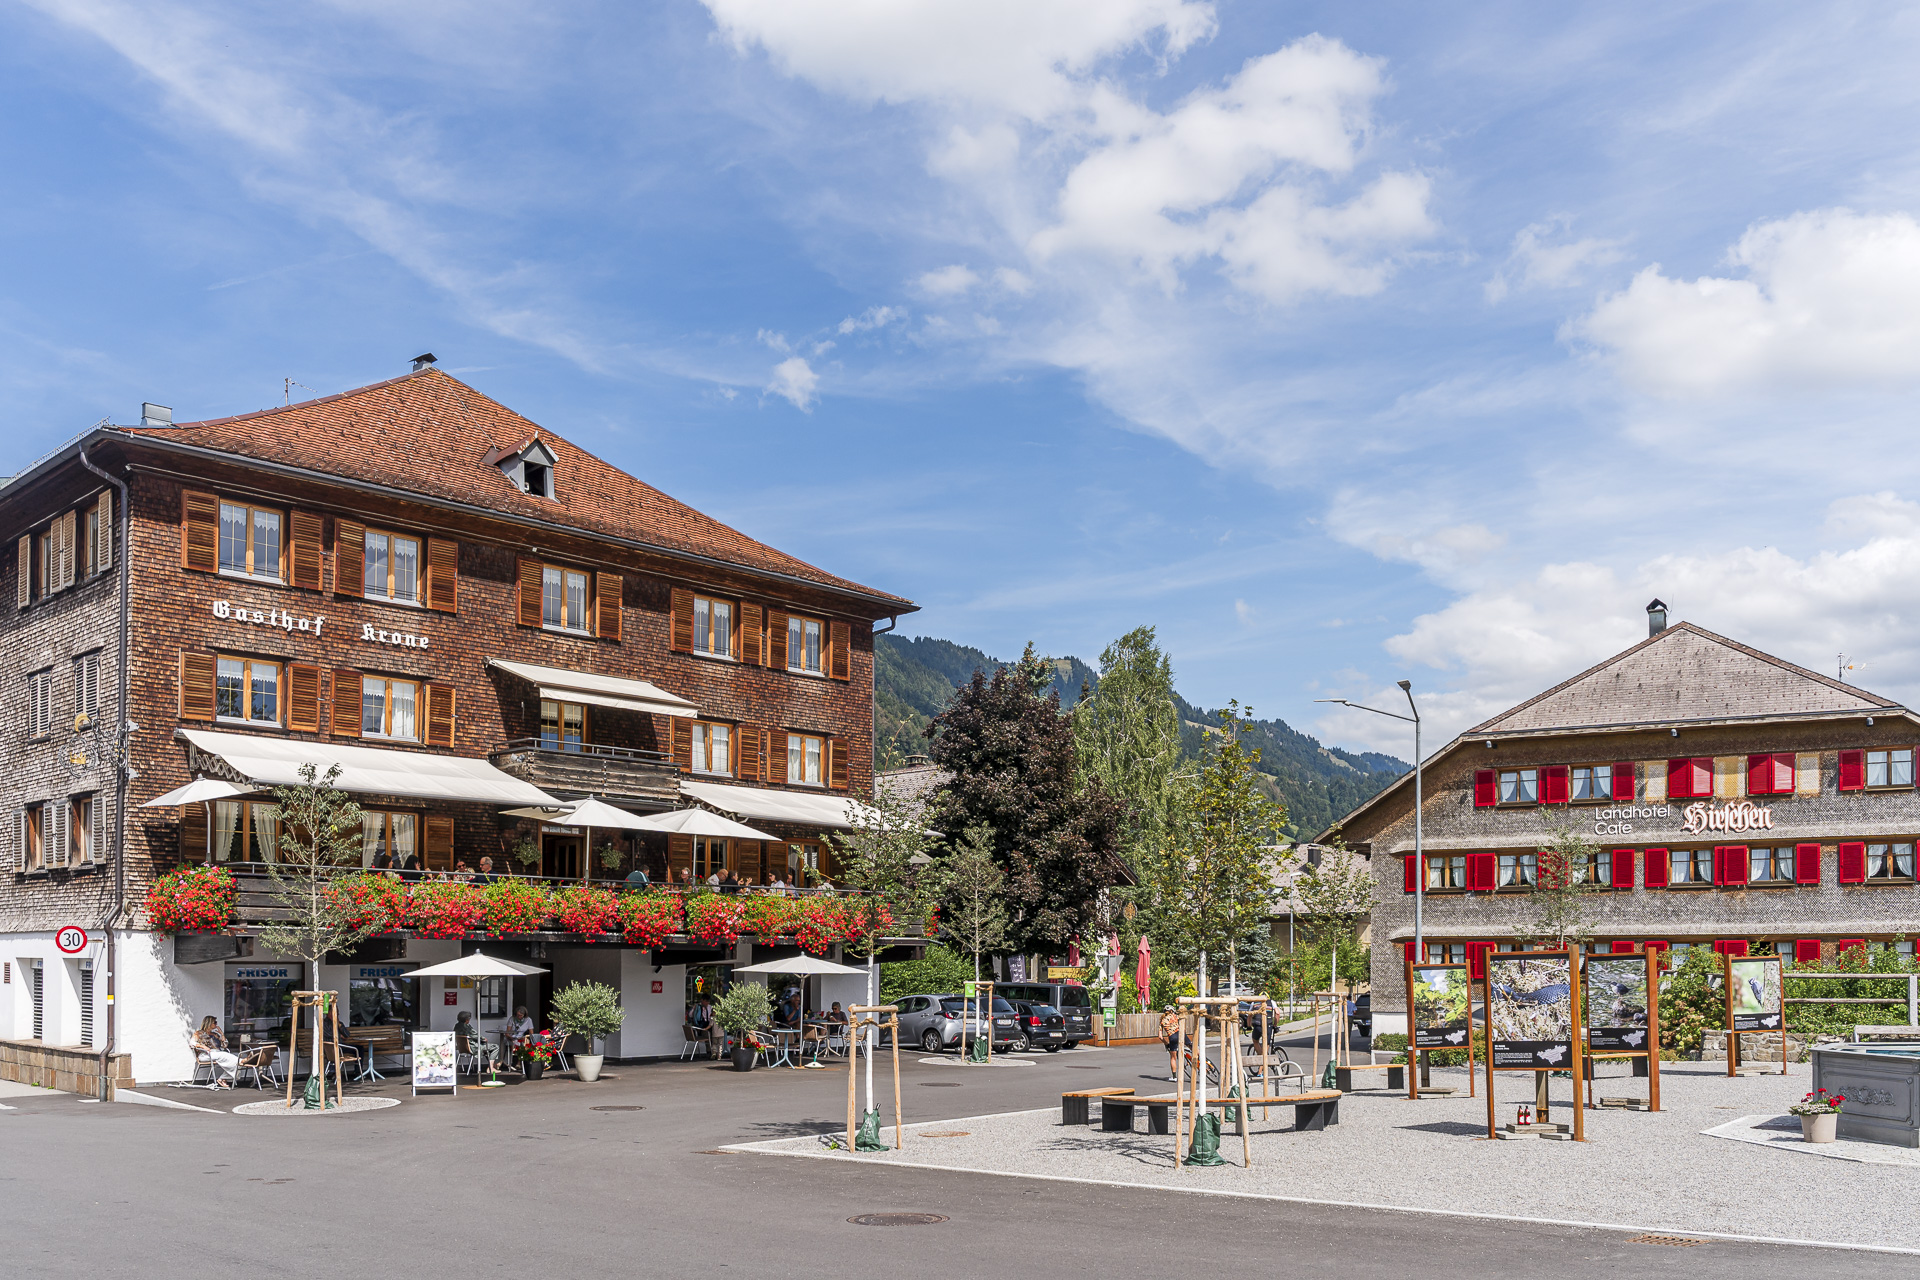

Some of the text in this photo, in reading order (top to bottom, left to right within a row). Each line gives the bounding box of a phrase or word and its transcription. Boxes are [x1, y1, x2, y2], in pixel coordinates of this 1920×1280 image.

[212, 600, 429, 650] Gasthof Krone
[1595, 804, 1671, 820] Landhotel
[1682, 801, 1775, 835] Hirschen
[1594, 821, 1632, 835] Cafe
[63, 933, 80, 947] 30
[237, 965, 288, 977] FRISÖR
